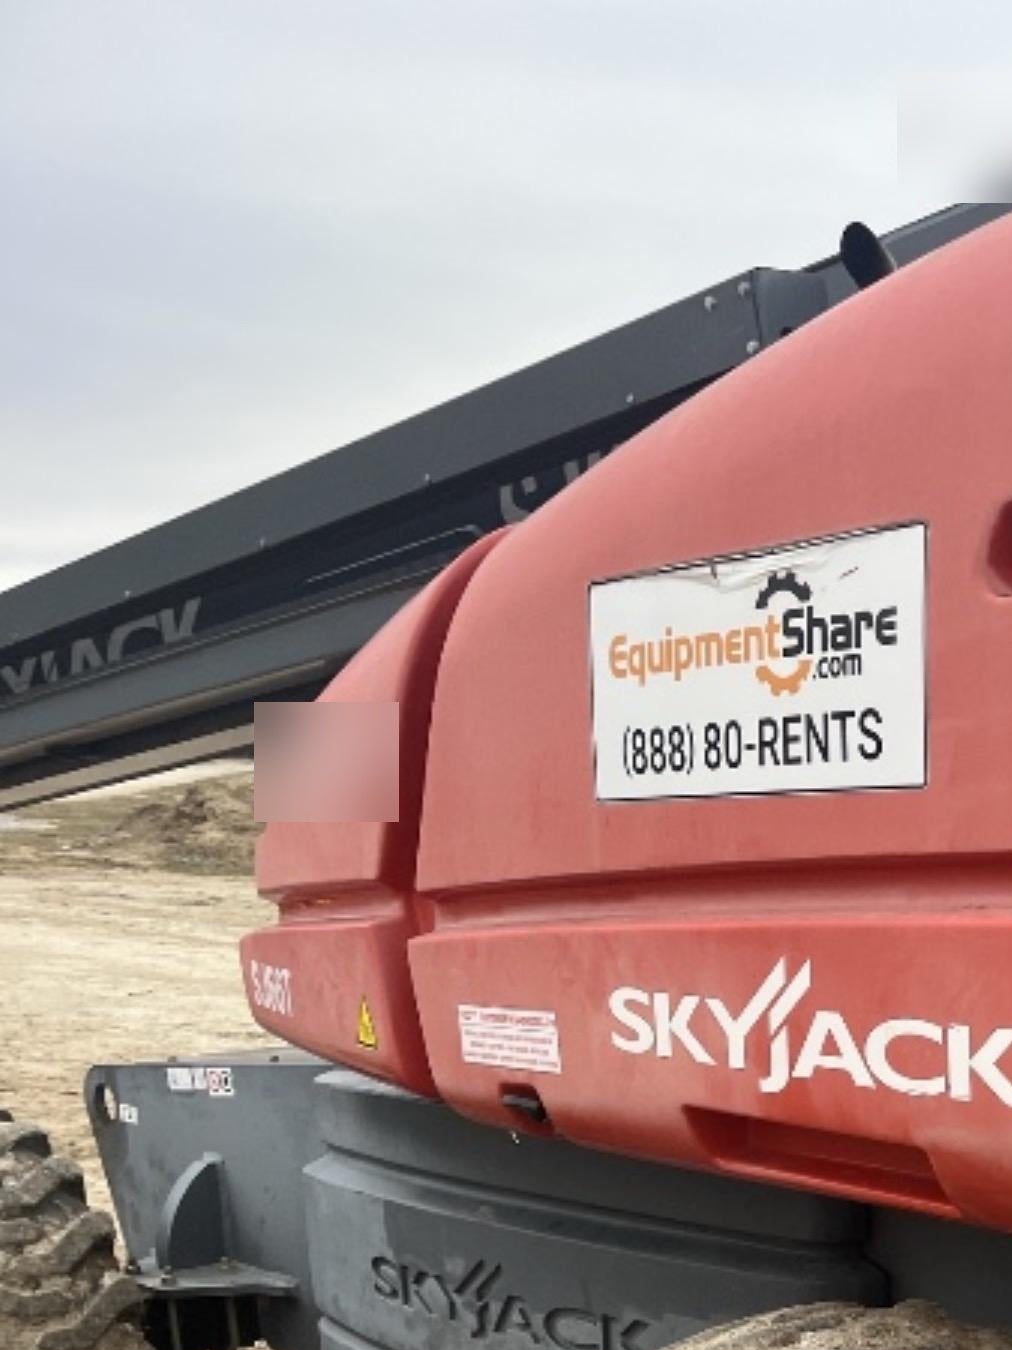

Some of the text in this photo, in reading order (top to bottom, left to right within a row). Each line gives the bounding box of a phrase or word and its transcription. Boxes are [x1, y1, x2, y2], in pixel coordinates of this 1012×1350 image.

[608, 606, 898, 687] EquipmentShare
[812, 652, 863, 680] .com
[622, 707, 884, 777] (888) 80-RENTS
